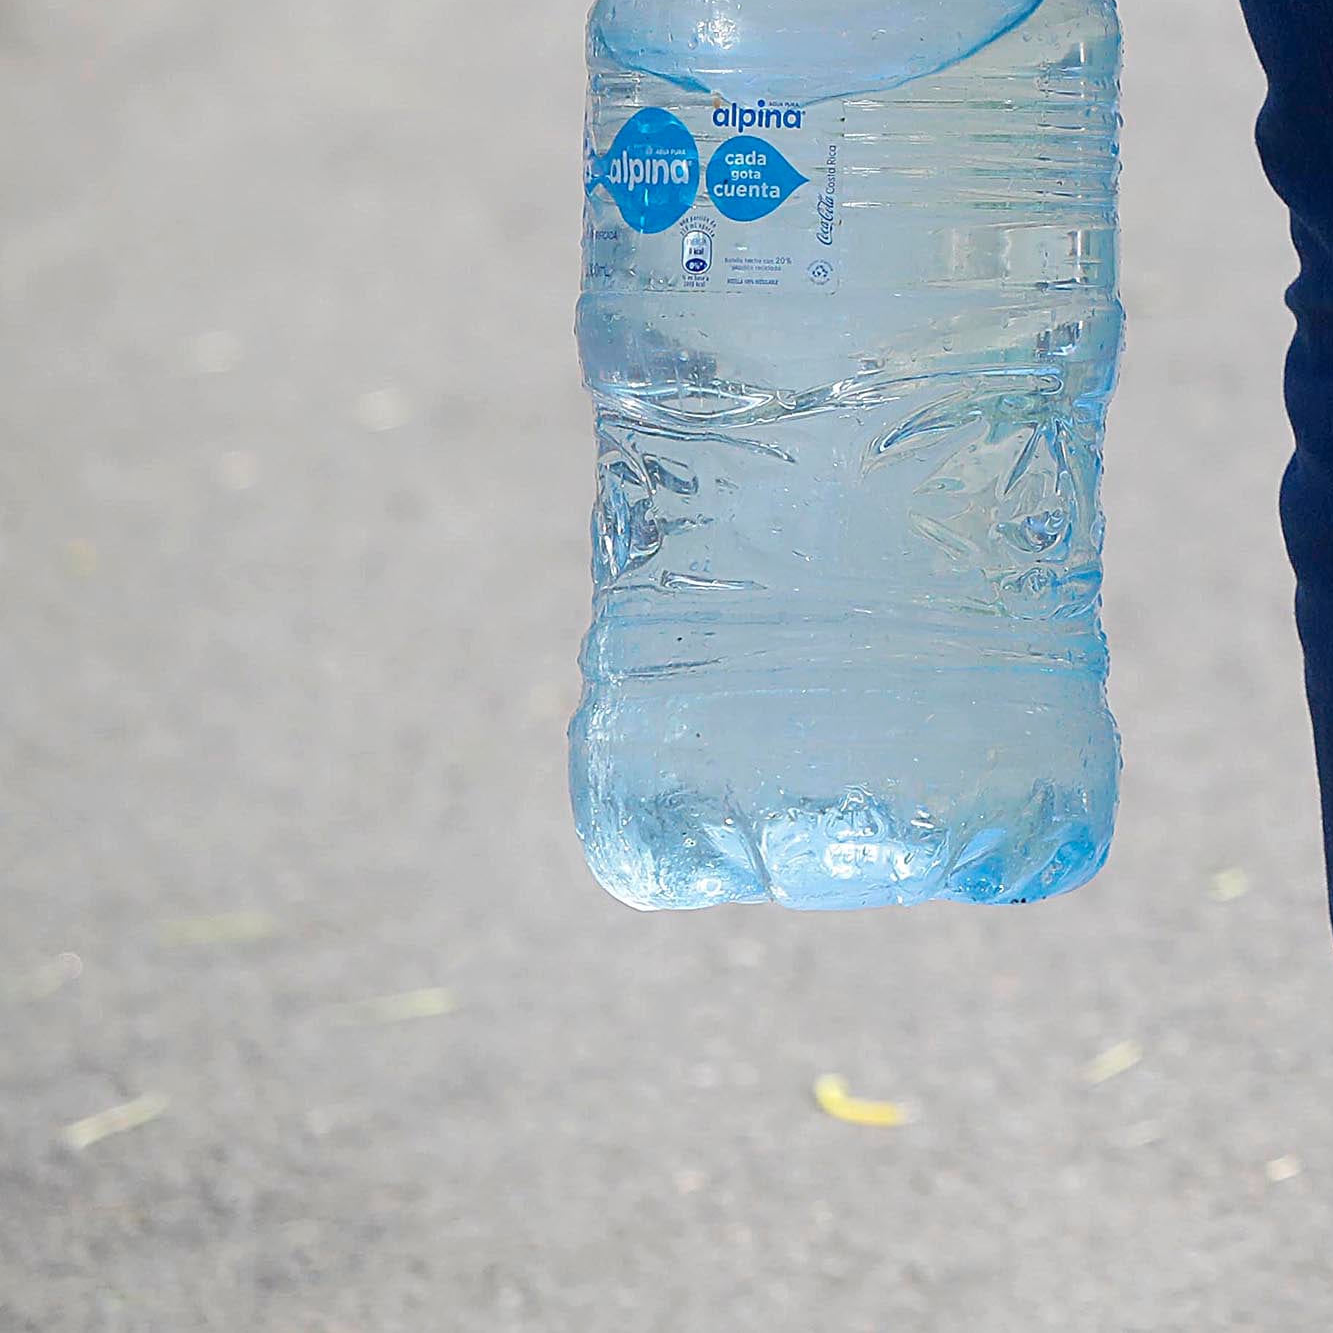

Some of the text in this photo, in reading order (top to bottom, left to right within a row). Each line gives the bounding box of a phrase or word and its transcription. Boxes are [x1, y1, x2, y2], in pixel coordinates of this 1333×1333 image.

[712, 99, 801, 133] alpina
[724, 150, 767, 165] cada
[826, 145, 837, 165] Rica
[610, 150, 690, 191] alpina
[731, 169, 761, 180] gota
[825, 167, 836, 194] Costa
[713, 182, 781, 198] cuenta
[775, 256, 792, 265] 20%
